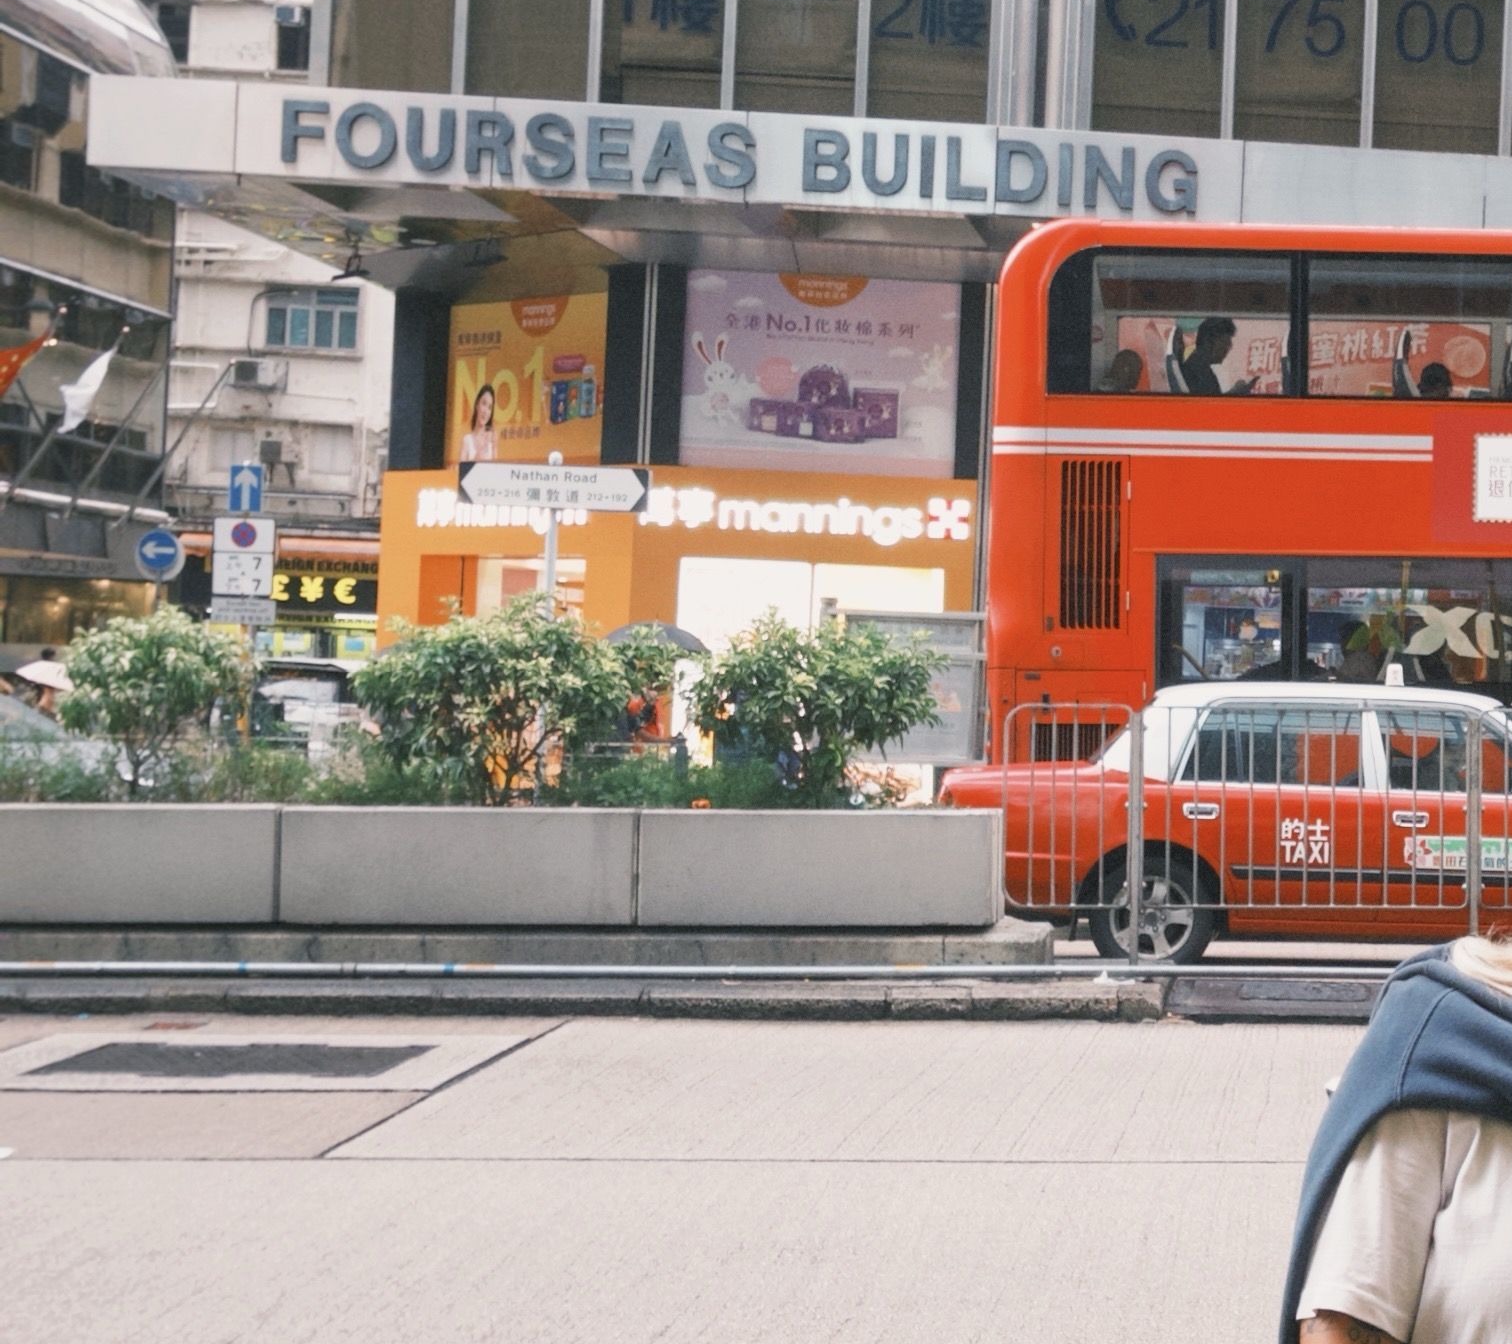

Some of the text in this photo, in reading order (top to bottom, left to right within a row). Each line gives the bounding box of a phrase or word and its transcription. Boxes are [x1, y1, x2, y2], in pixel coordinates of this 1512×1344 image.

[1394, 0, 1486, 66] 00
[280, 98, 1199, 213] FOURSEAS BUILDING
[454, 344, 545, 426] No.1
[509, 469, 598, 484] Nathan Road
[719, 497, 924, 546] mannings
[252, 556, 263, 571] 7
[318, 558, 377, 573] EXCHANG
[251, 578, 262, 592] 7
[1280, 817, 1330, 840] 的士
[1280, 841, 1330, 865] TAXI
